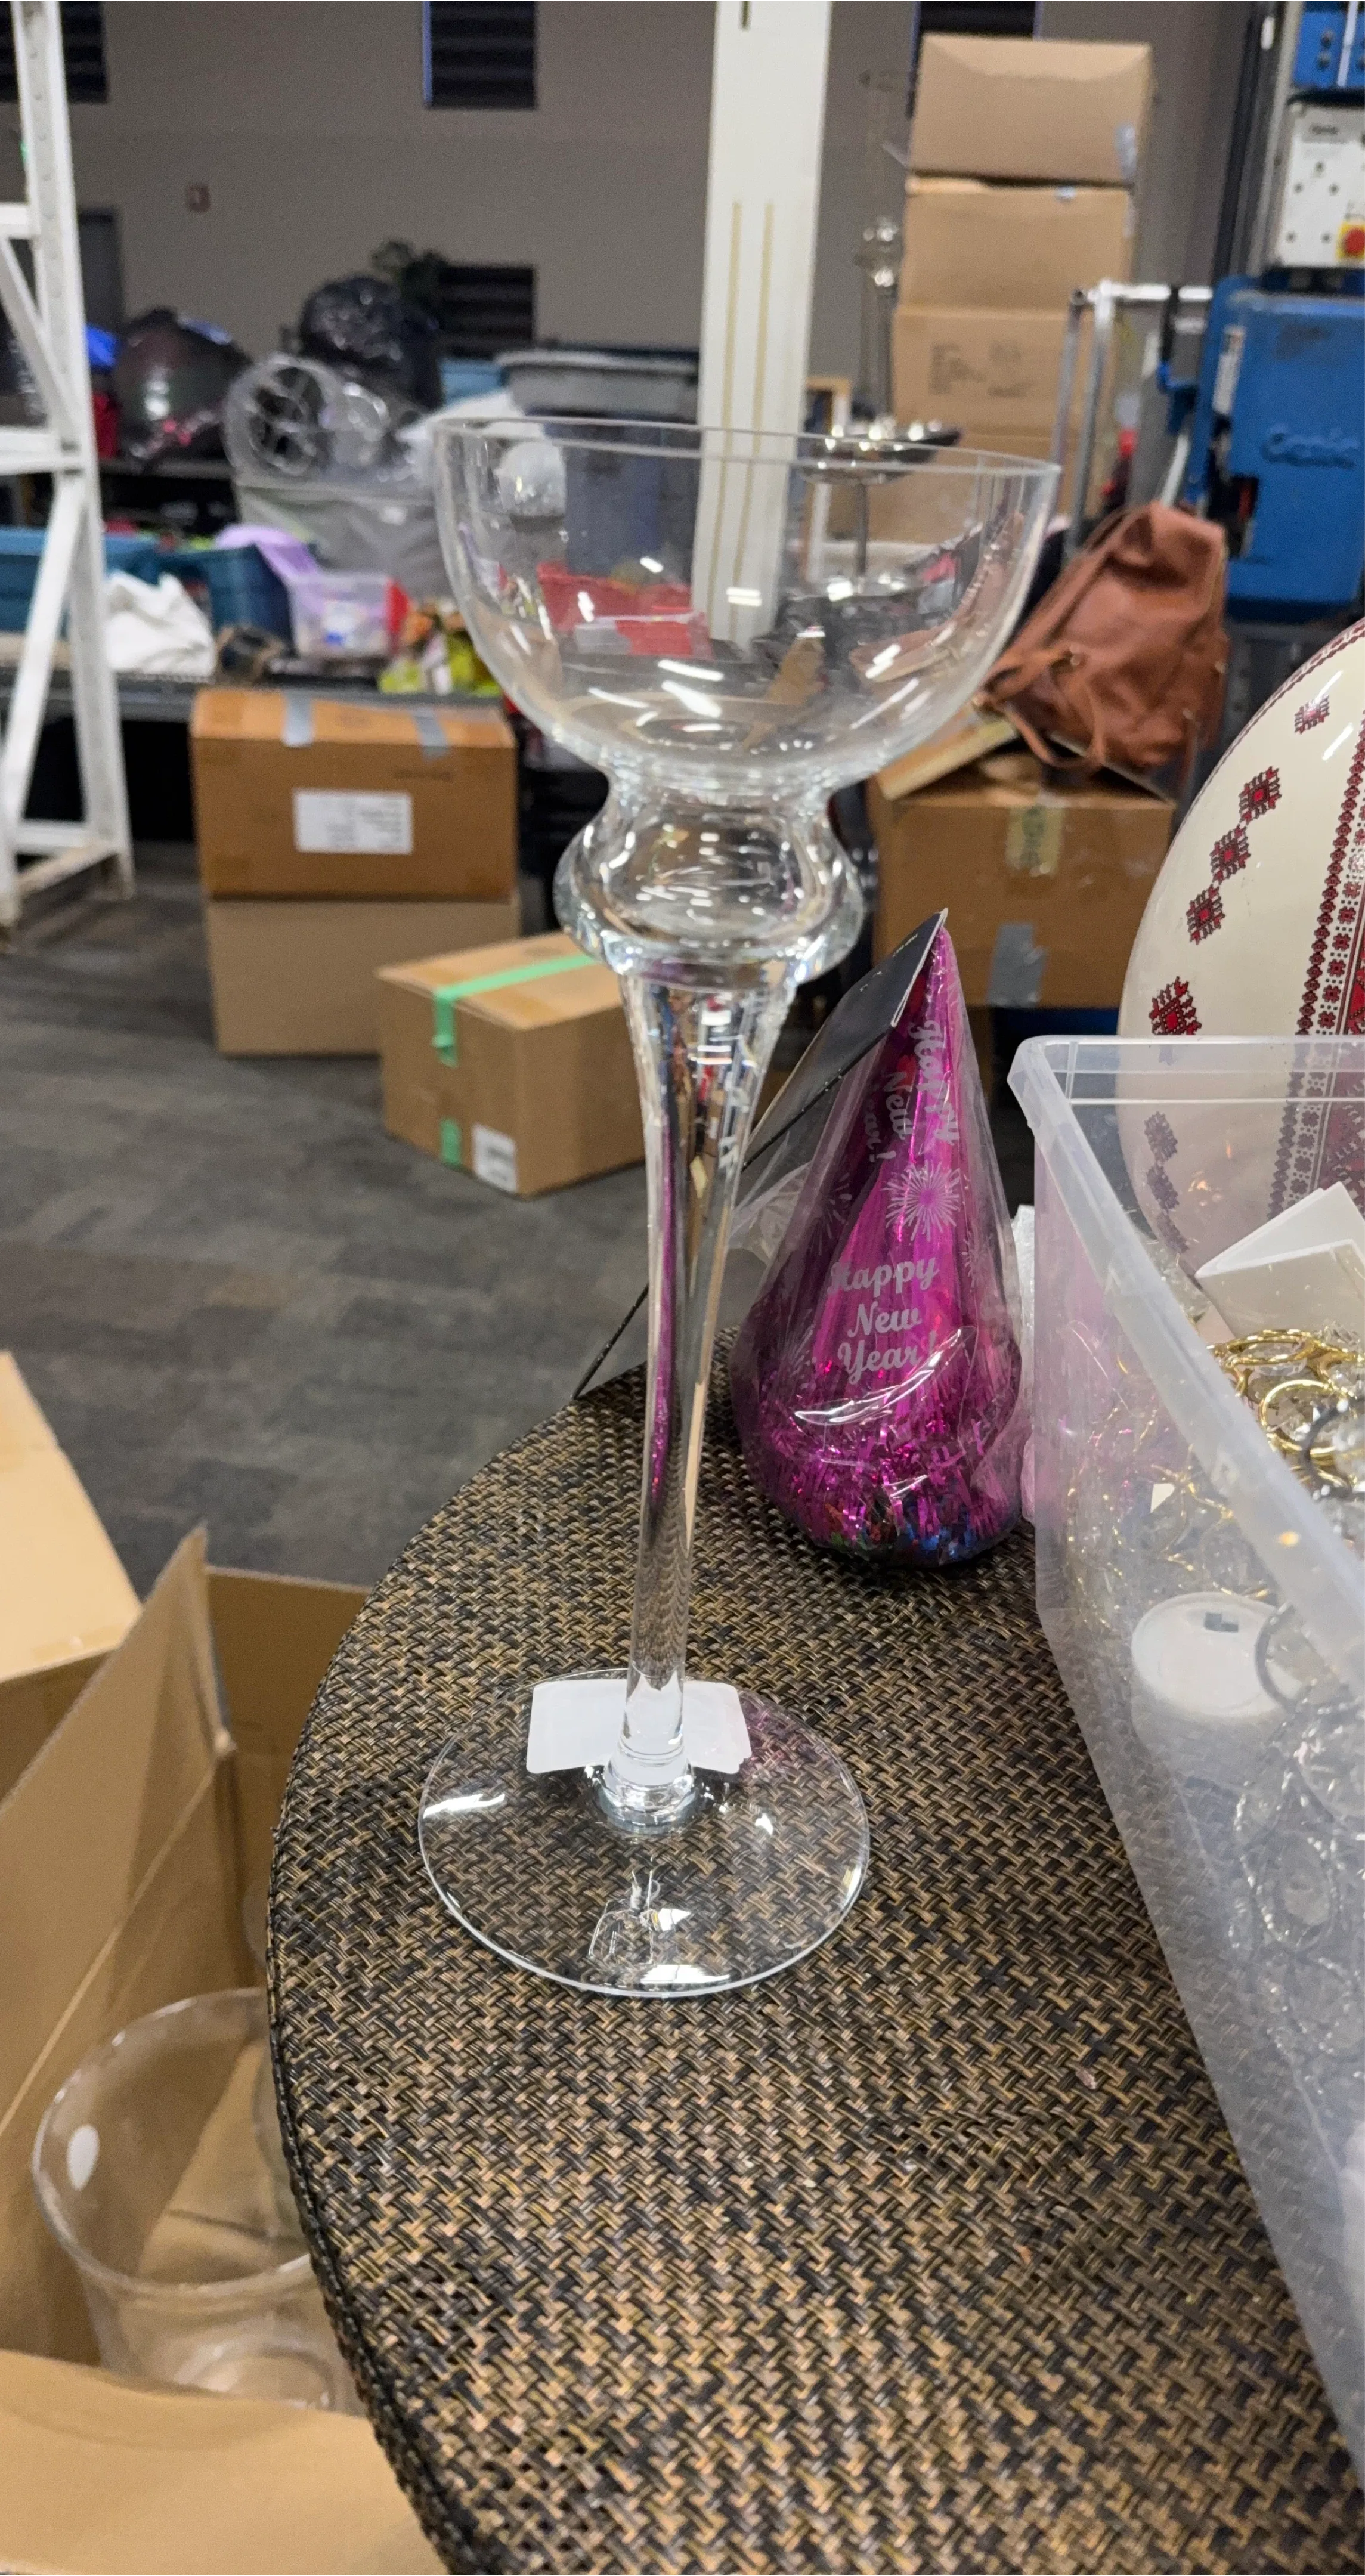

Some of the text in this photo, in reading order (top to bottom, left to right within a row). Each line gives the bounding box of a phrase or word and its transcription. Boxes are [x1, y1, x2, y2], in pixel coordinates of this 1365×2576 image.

[863, 1078, 897, 1162] ear!
[880, 1070, 915, 1140] New
[827, 1257, 940, 1298] Happy
[847, 1301, 923, 1337] New
